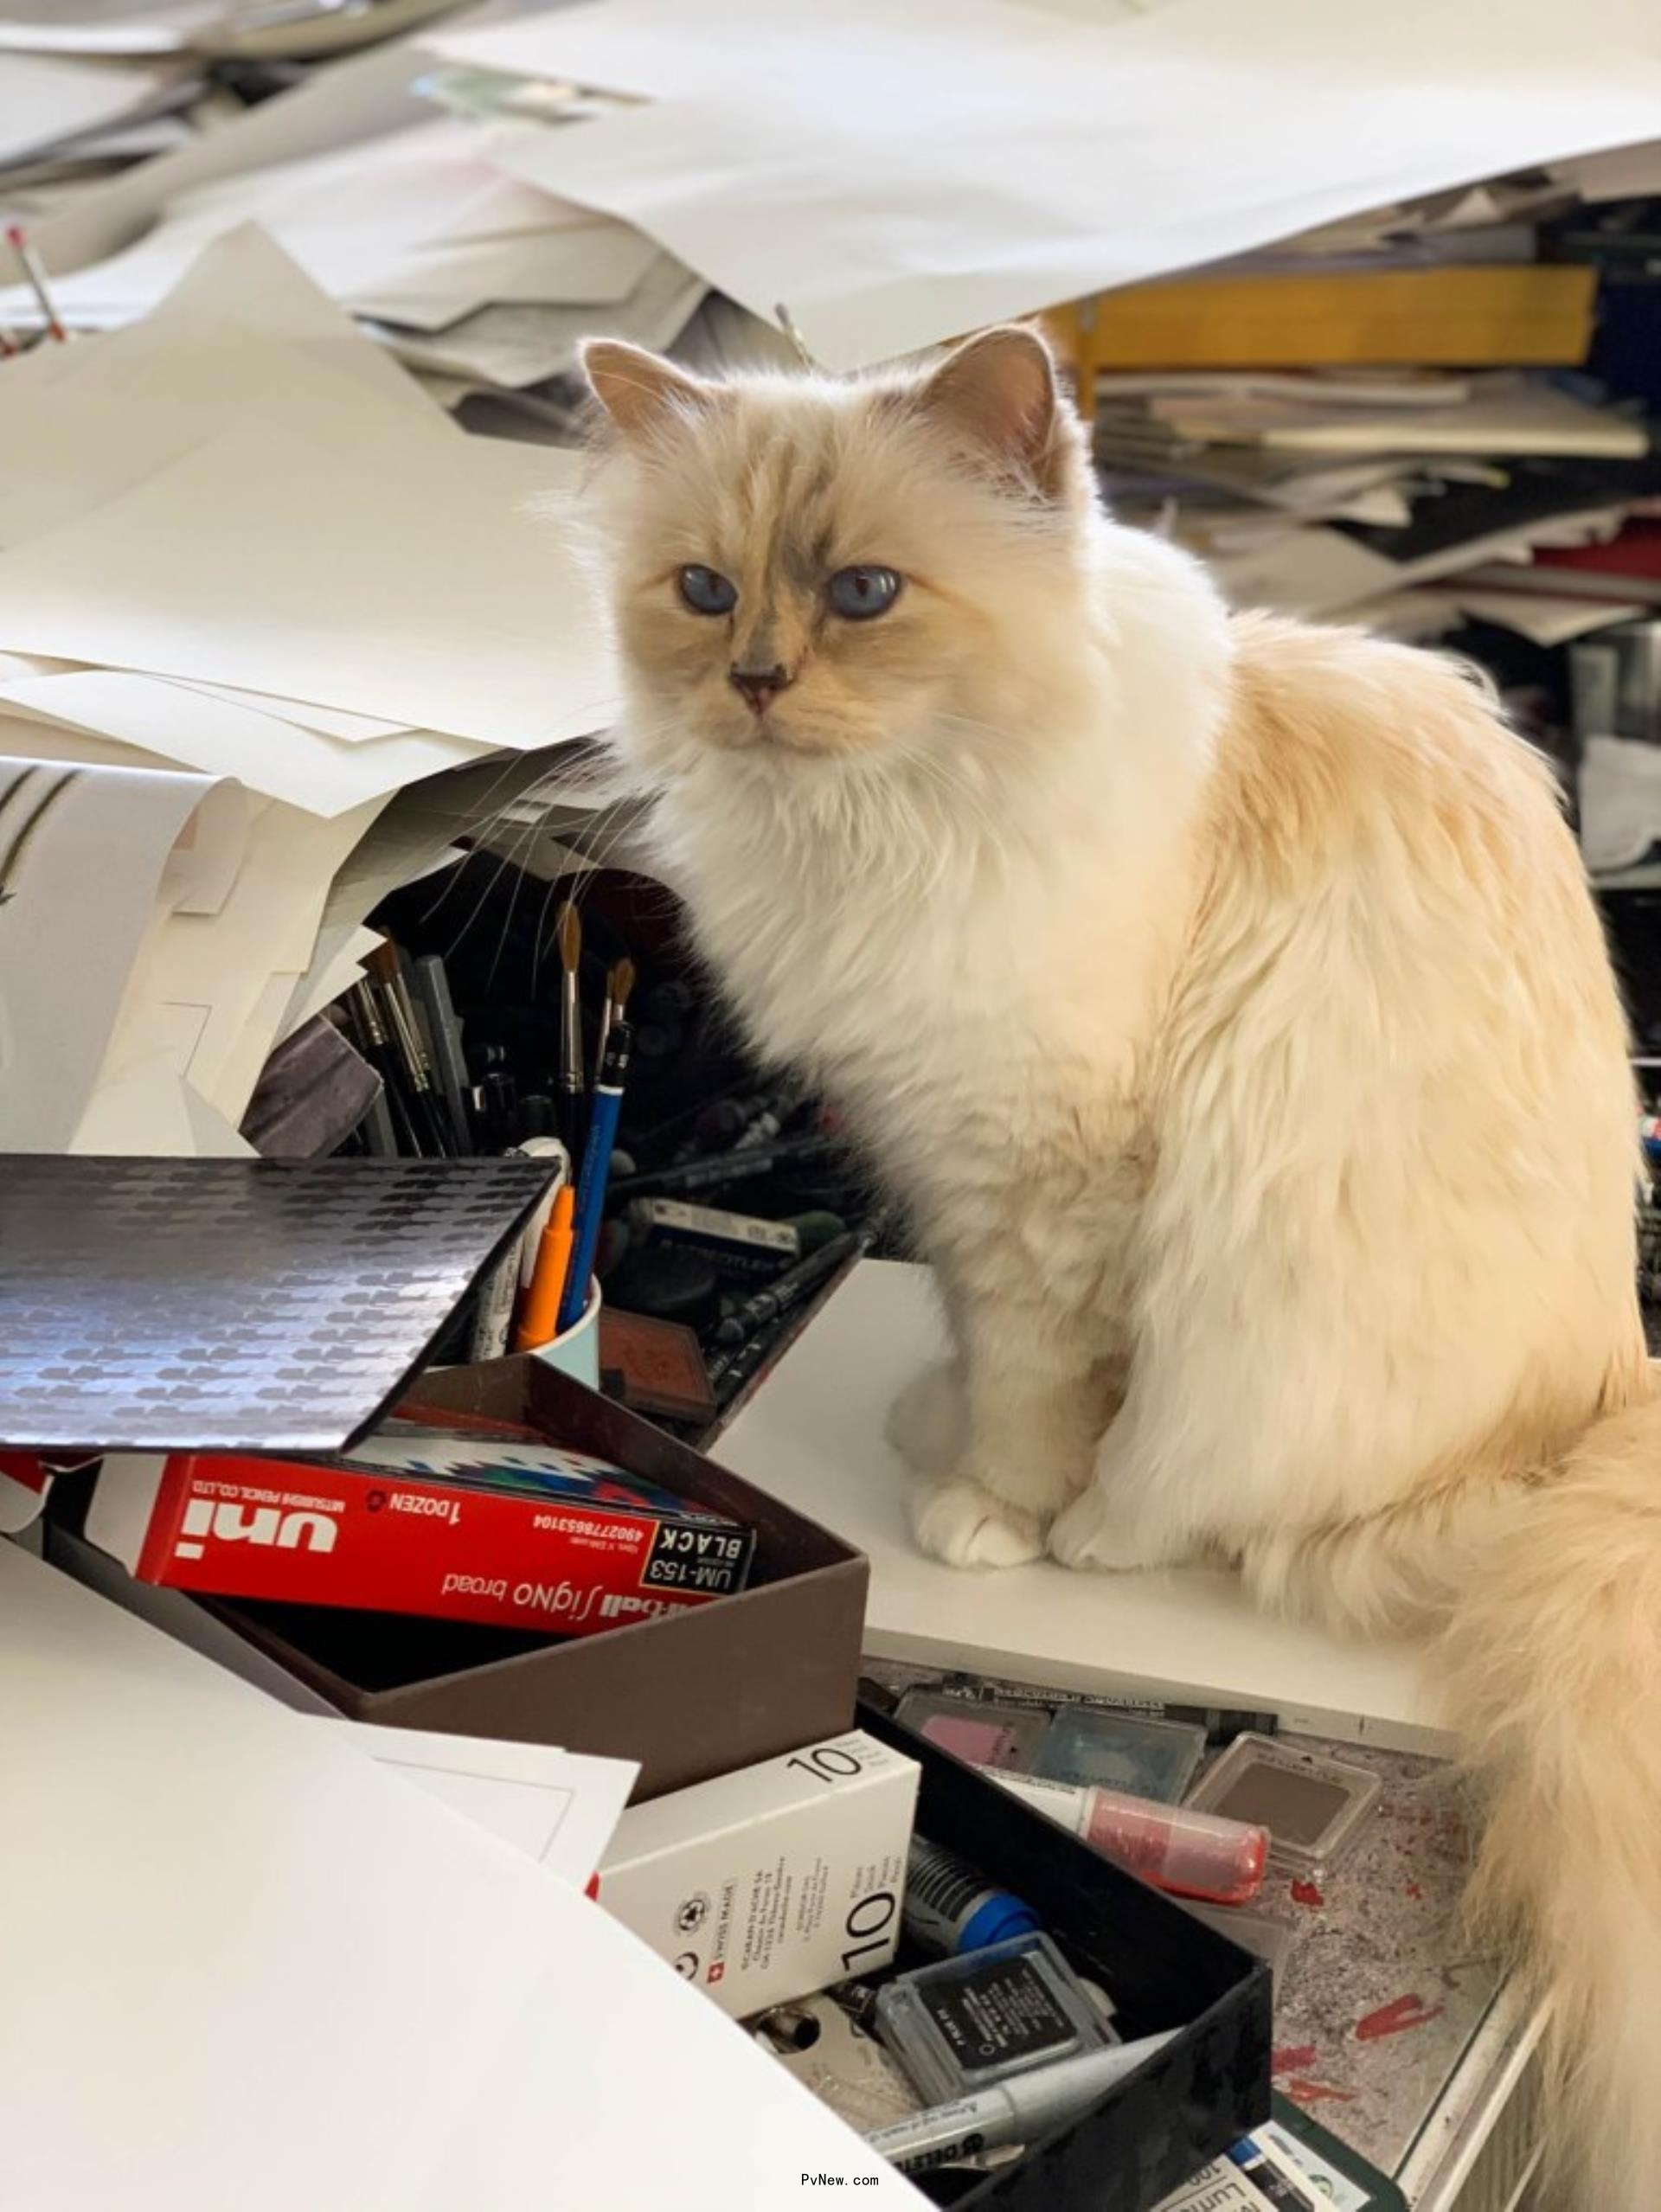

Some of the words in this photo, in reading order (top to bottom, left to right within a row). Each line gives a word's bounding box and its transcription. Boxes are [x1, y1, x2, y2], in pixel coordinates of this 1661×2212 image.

[240, 1487, 279, 1504] PENCIL
[281, 1493, 346, 1513] MITSUBISHI
[174, 1497, 339, 1560] uni
[532, 1514, 645, 1543] 4902778653104
[660, 1528, 742, 1560] BLACK
[441, 1573, 508, 1601] broad
[650, 1559, 733, 1590] UM-153
[786, 1747, 863, 1784] 10
[839, 1890, 897, 1972] 10
